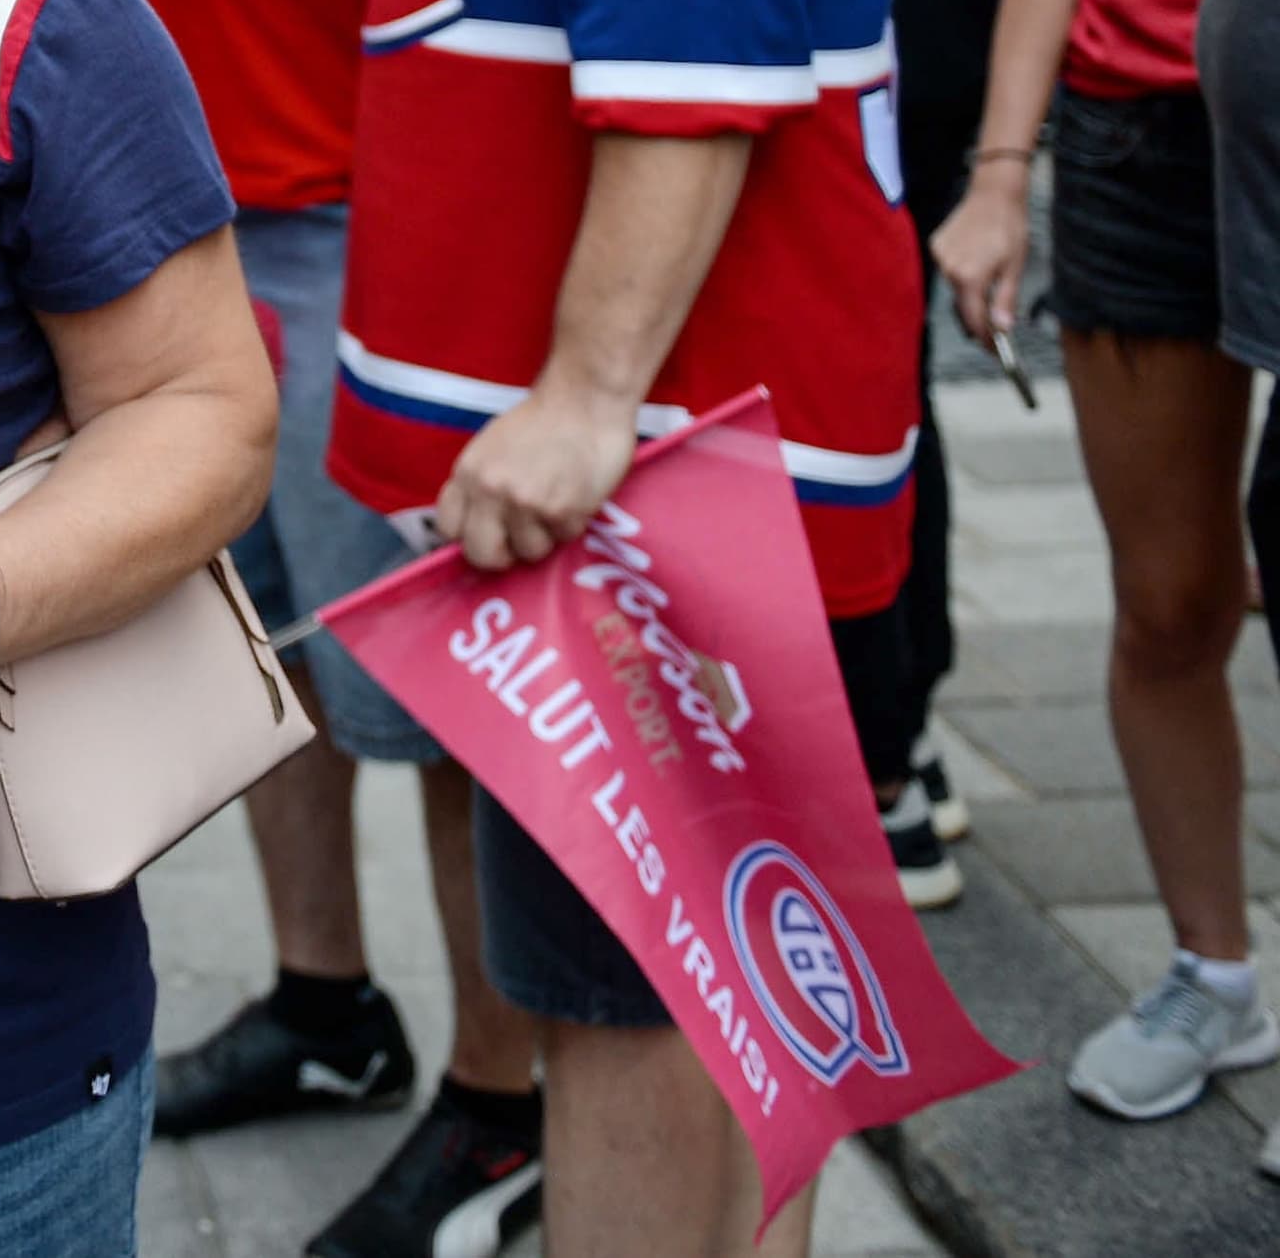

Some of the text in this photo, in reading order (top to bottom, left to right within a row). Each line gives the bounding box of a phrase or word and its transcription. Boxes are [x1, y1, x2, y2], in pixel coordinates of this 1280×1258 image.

[573, 500, 747, 773] Molson
[449, 597, 780, 1117] SALUT LES VRAIS!
